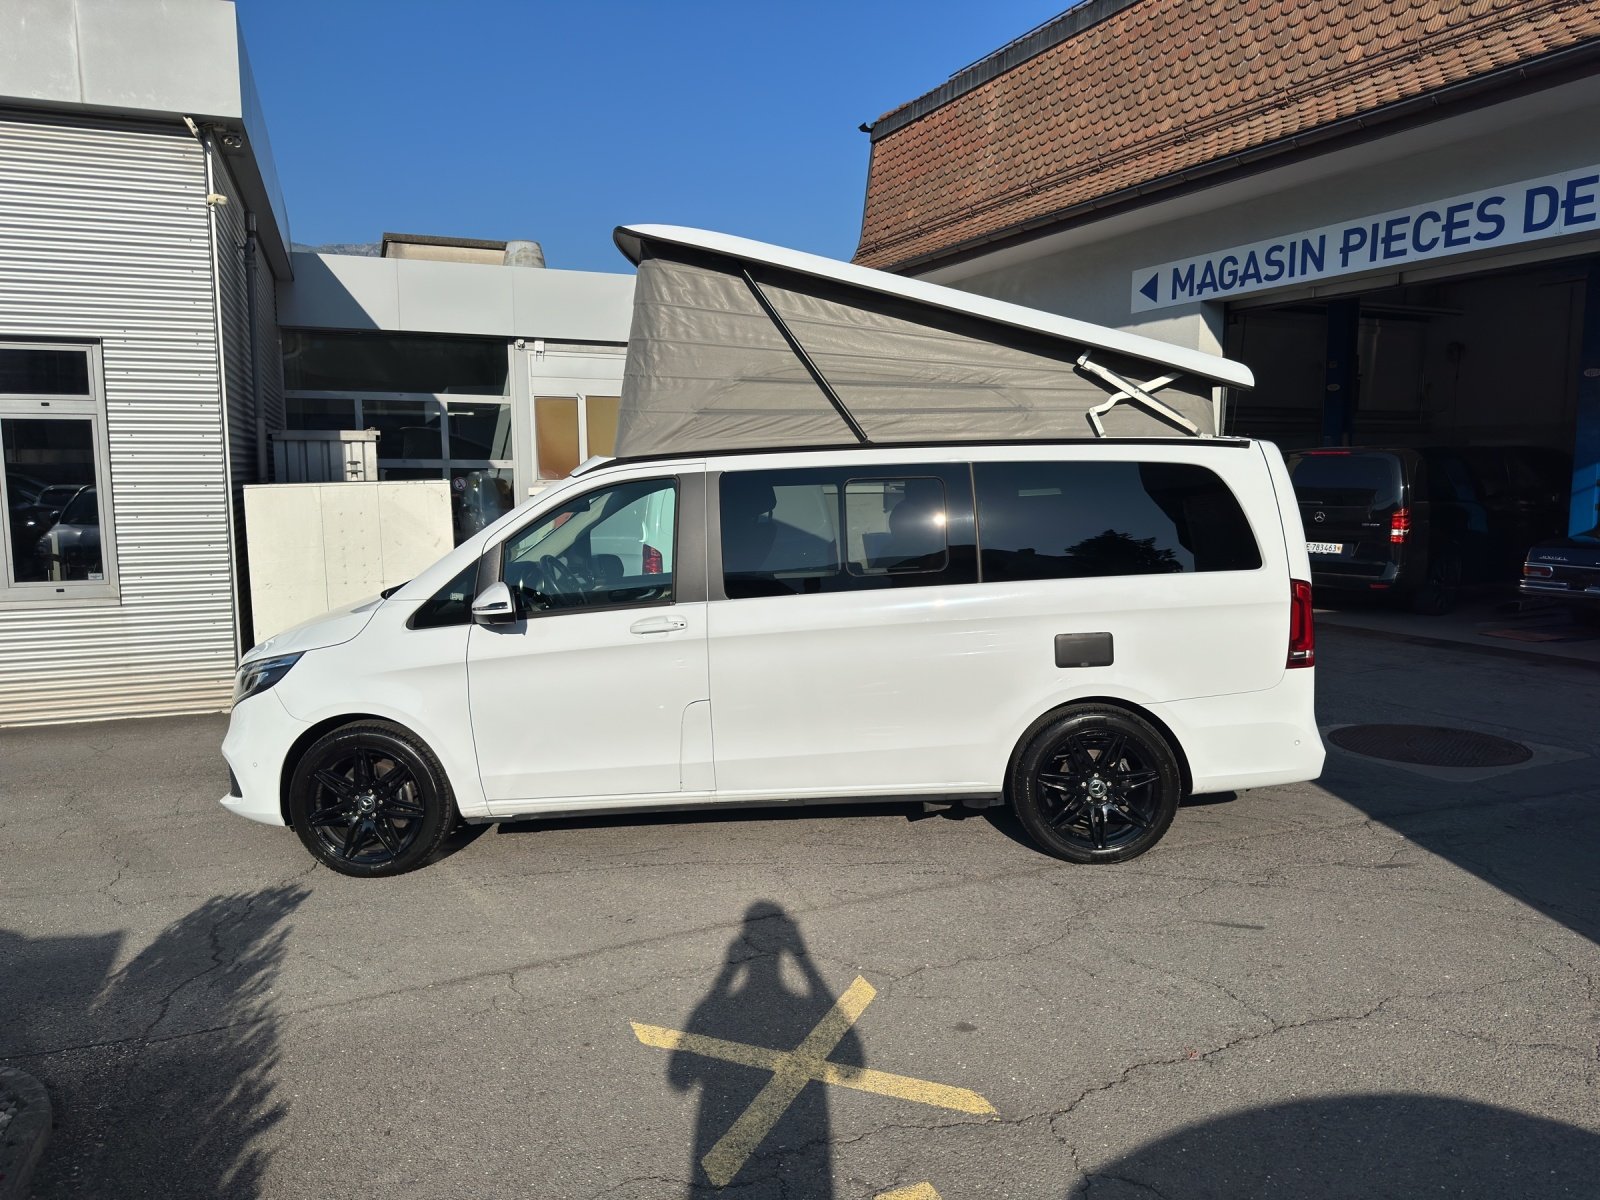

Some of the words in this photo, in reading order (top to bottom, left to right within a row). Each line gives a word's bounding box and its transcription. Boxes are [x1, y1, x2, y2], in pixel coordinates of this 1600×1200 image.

[1171, 234, 1327, 301] MAGASIN
[1338, 195, 1506, 269] PIECES
[1522, 174, 1600, 234] DE
